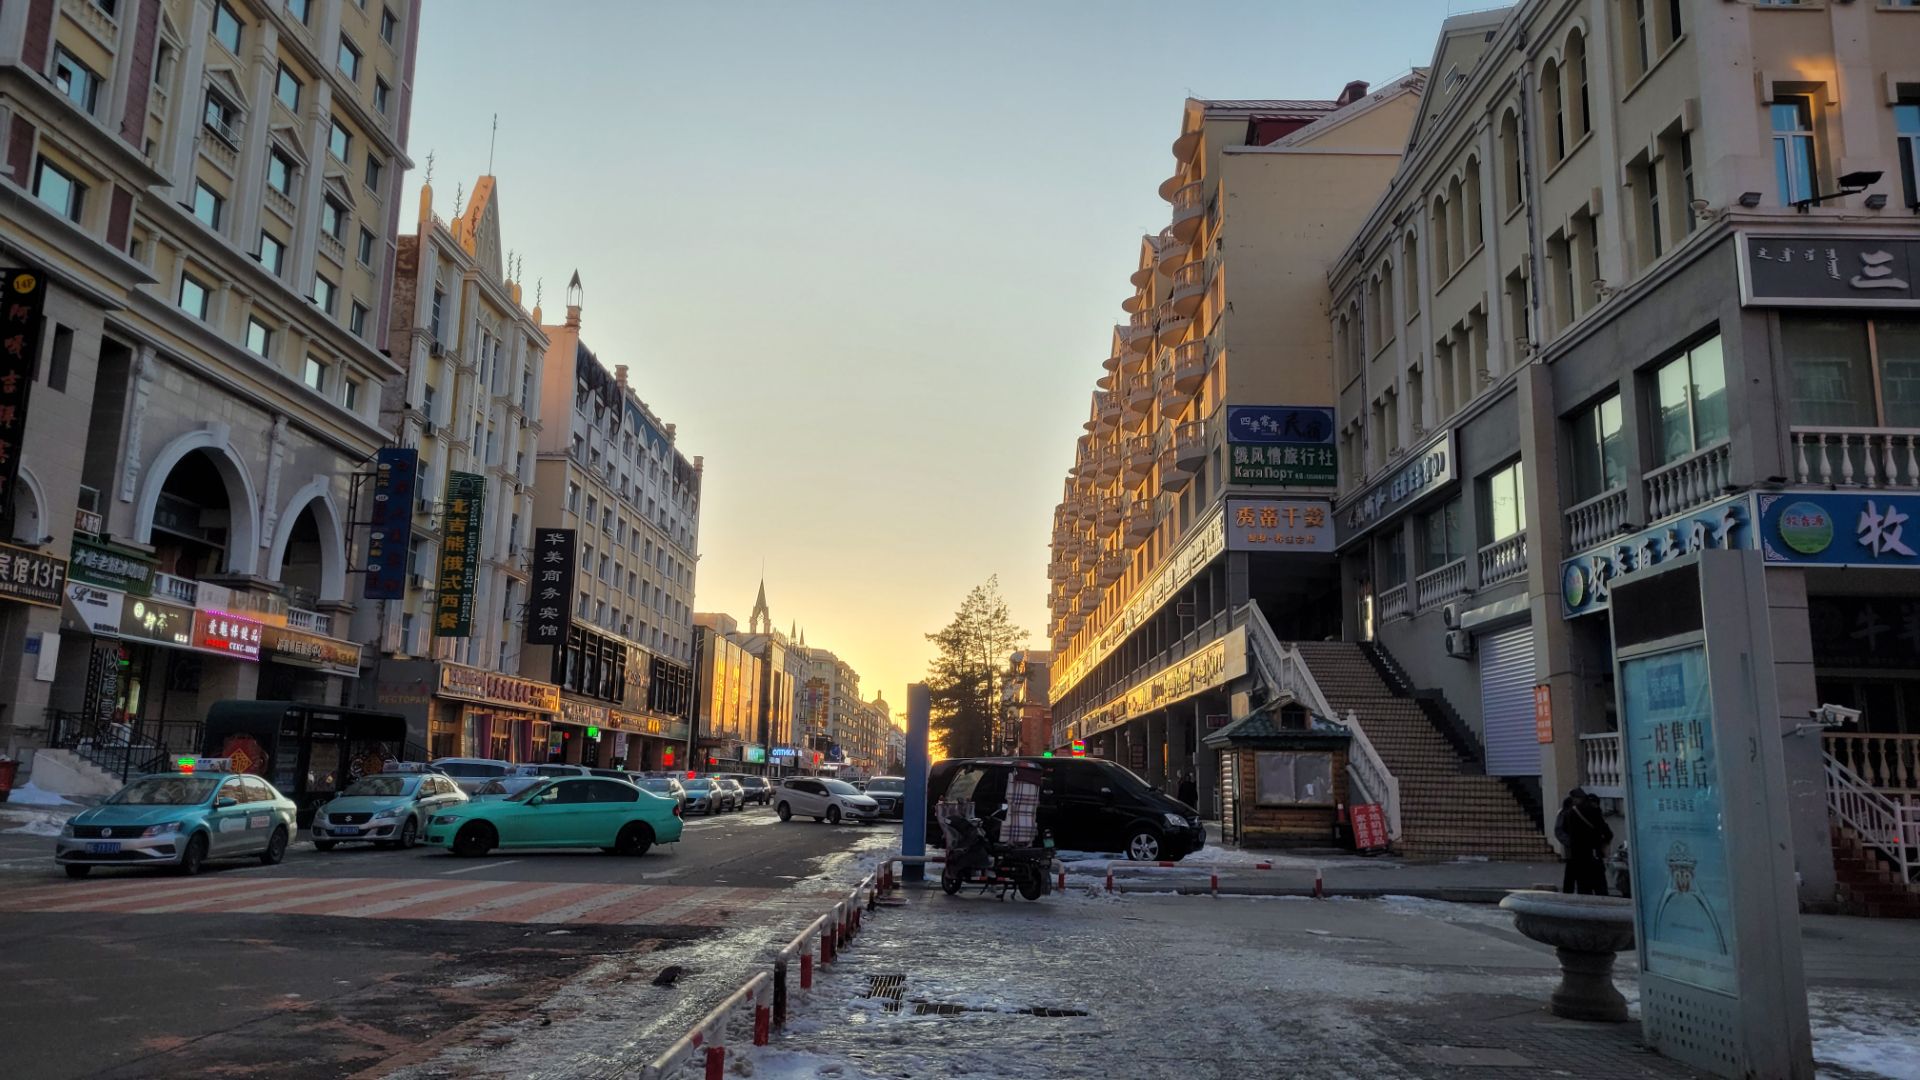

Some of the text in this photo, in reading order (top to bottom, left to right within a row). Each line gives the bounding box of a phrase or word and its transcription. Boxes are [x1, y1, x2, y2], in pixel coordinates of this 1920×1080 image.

[15, 278, 33, 290] 14F
[1849, 250, 1909, 289] 三
[1234, 446, 1334, 467] 俄风情旅行社
[1235, 466, 1263, 479] Катя
[1265, 467, 1294, 481] Порт
[1857, 499, 1918, 559] 牧
[538, 531, 566, 637] 华美商务宾馆
[772, 747, 796, 757] ОПТИКА
[1639, 719, 1705, 753] 一店售出
[1642, 756, 1709, 790] 千店售后
